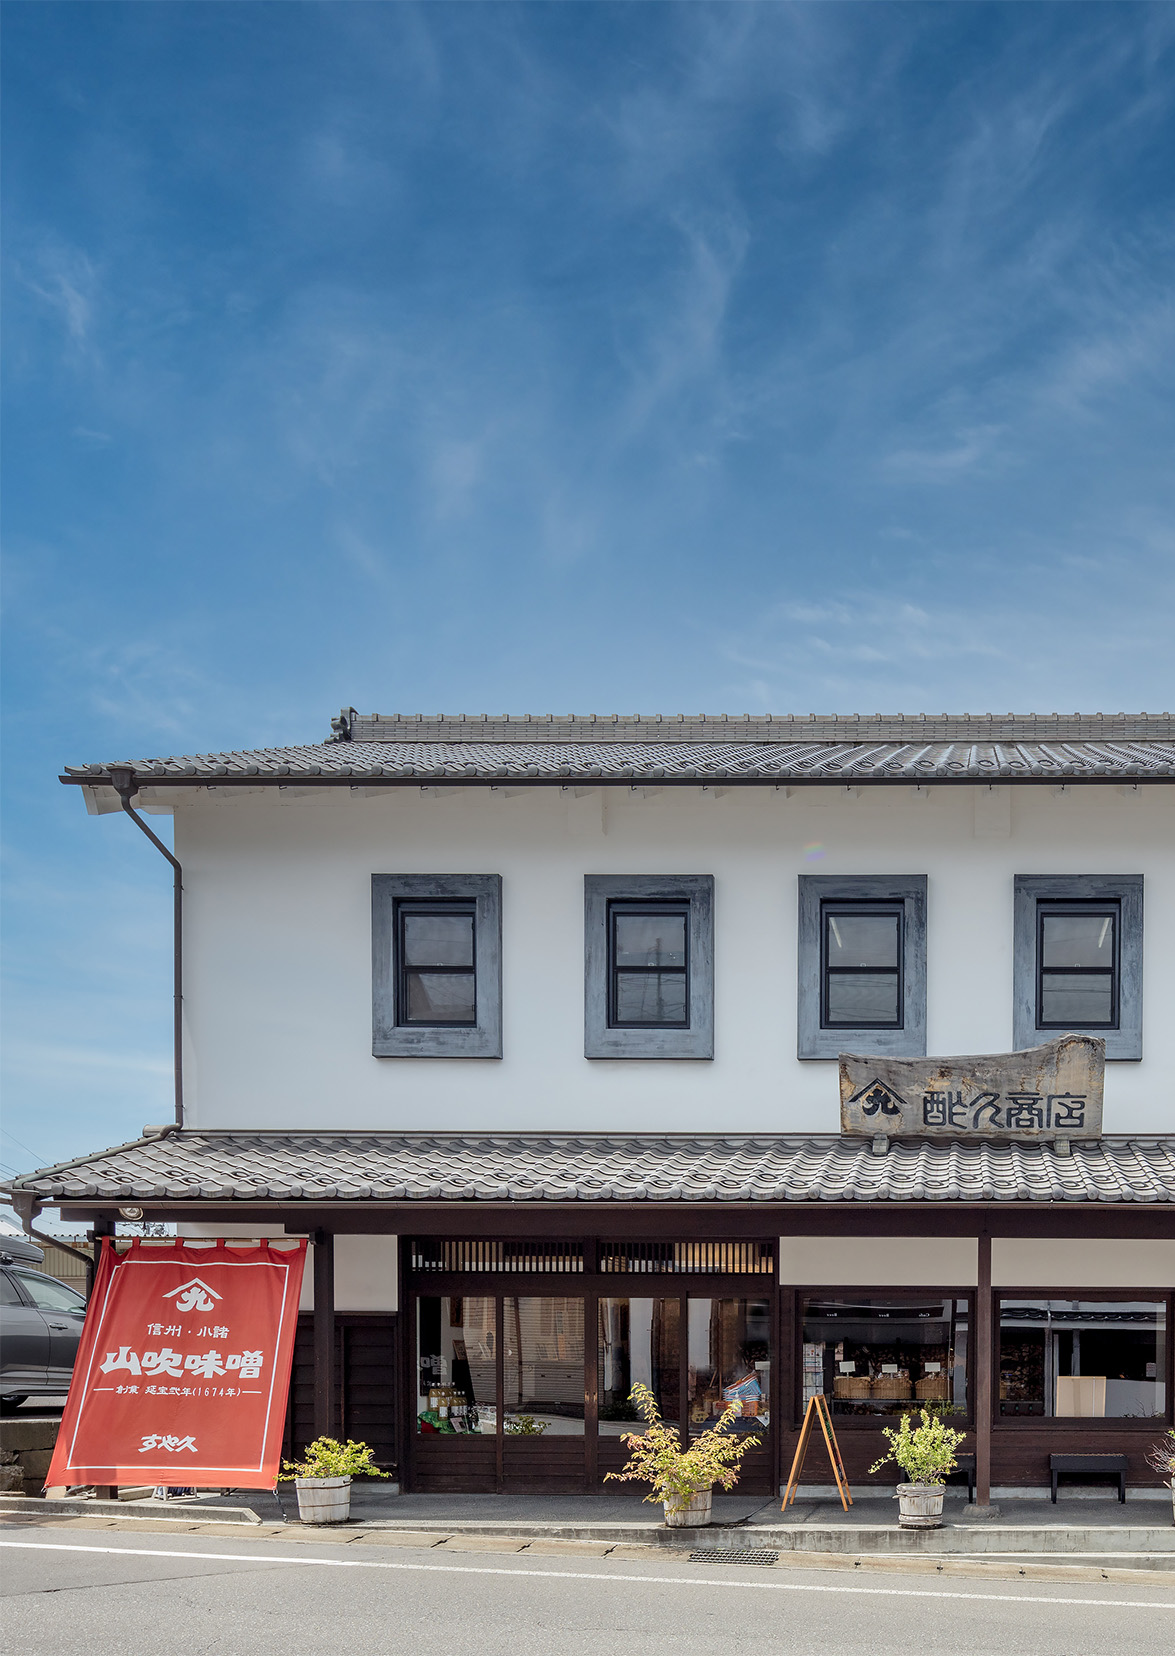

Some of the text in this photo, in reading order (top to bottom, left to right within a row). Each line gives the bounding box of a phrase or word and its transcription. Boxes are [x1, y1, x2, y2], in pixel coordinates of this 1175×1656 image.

[100, 1346, 264, 1379] 山吹味噌
[115, 1385, 140, 1395] 創業
[138, 1433, 198, 1453] すや久
